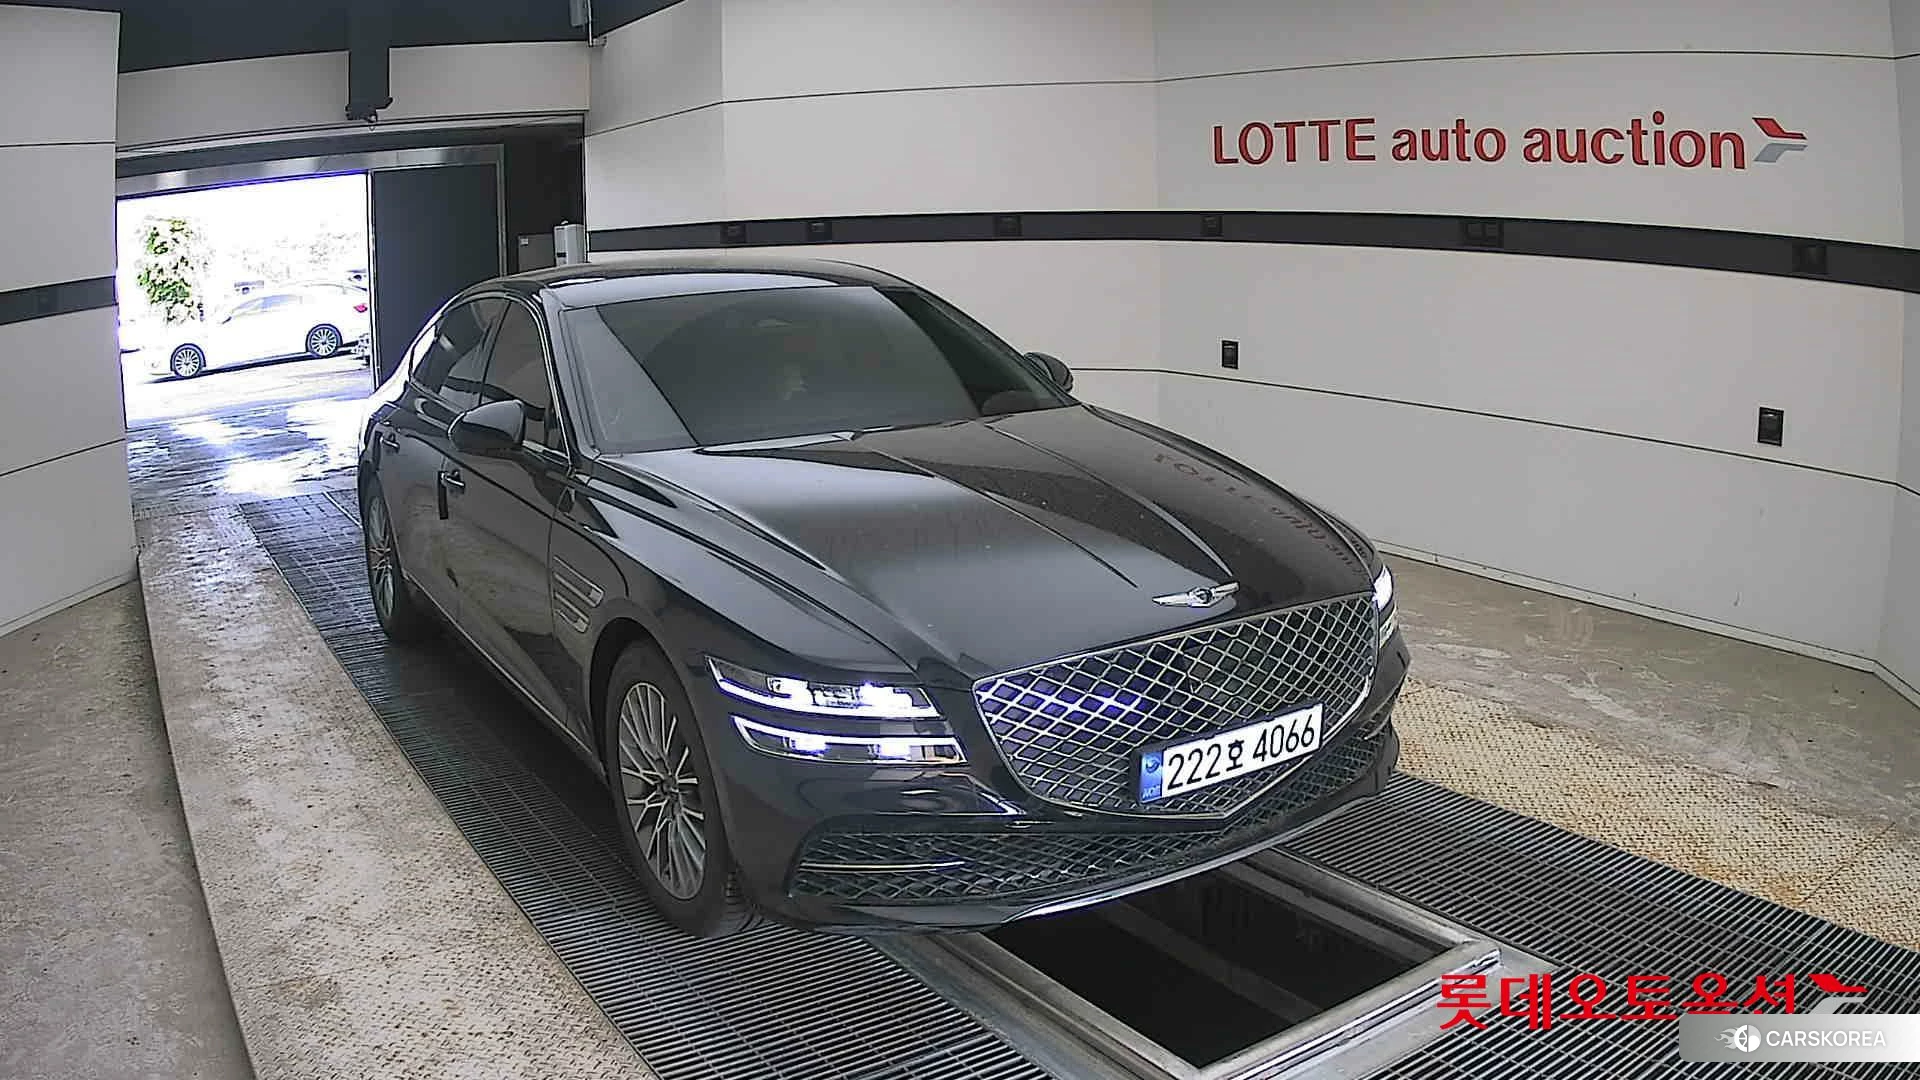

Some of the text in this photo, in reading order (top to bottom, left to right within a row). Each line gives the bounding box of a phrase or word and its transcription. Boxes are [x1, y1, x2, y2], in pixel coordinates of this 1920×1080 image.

[1213, 111, 1746, 170] LOTTE auto auction
[1167, 713, 1316, 791] 222호 4066
